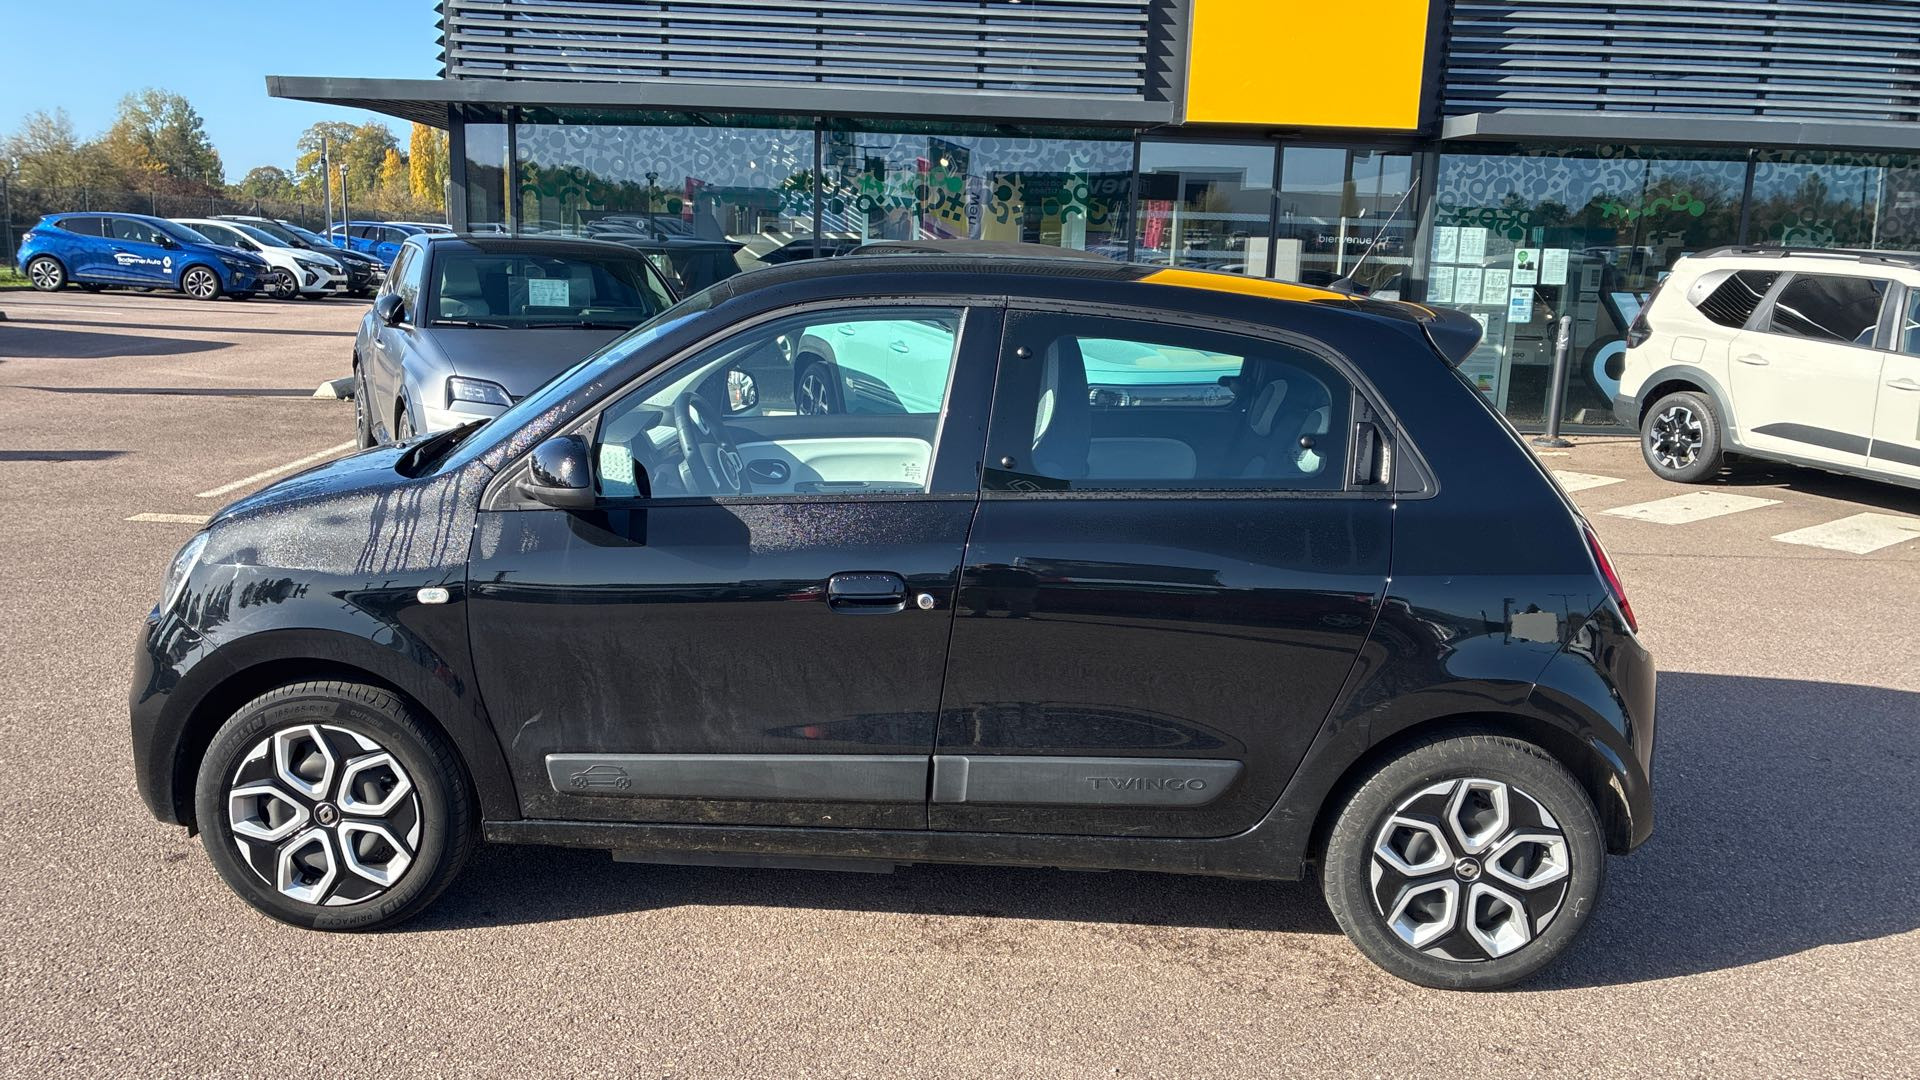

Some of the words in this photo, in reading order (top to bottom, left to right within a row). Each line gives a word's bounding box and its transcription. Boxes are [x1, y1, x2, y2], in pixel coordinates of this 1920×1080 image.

[969, 192, 981, 225] new
[1318, 233, 1372, 245] bienvenue
[1085, 776, 1207, 791] TWINGO
[328, 914, 373, 926] PRIMACY
